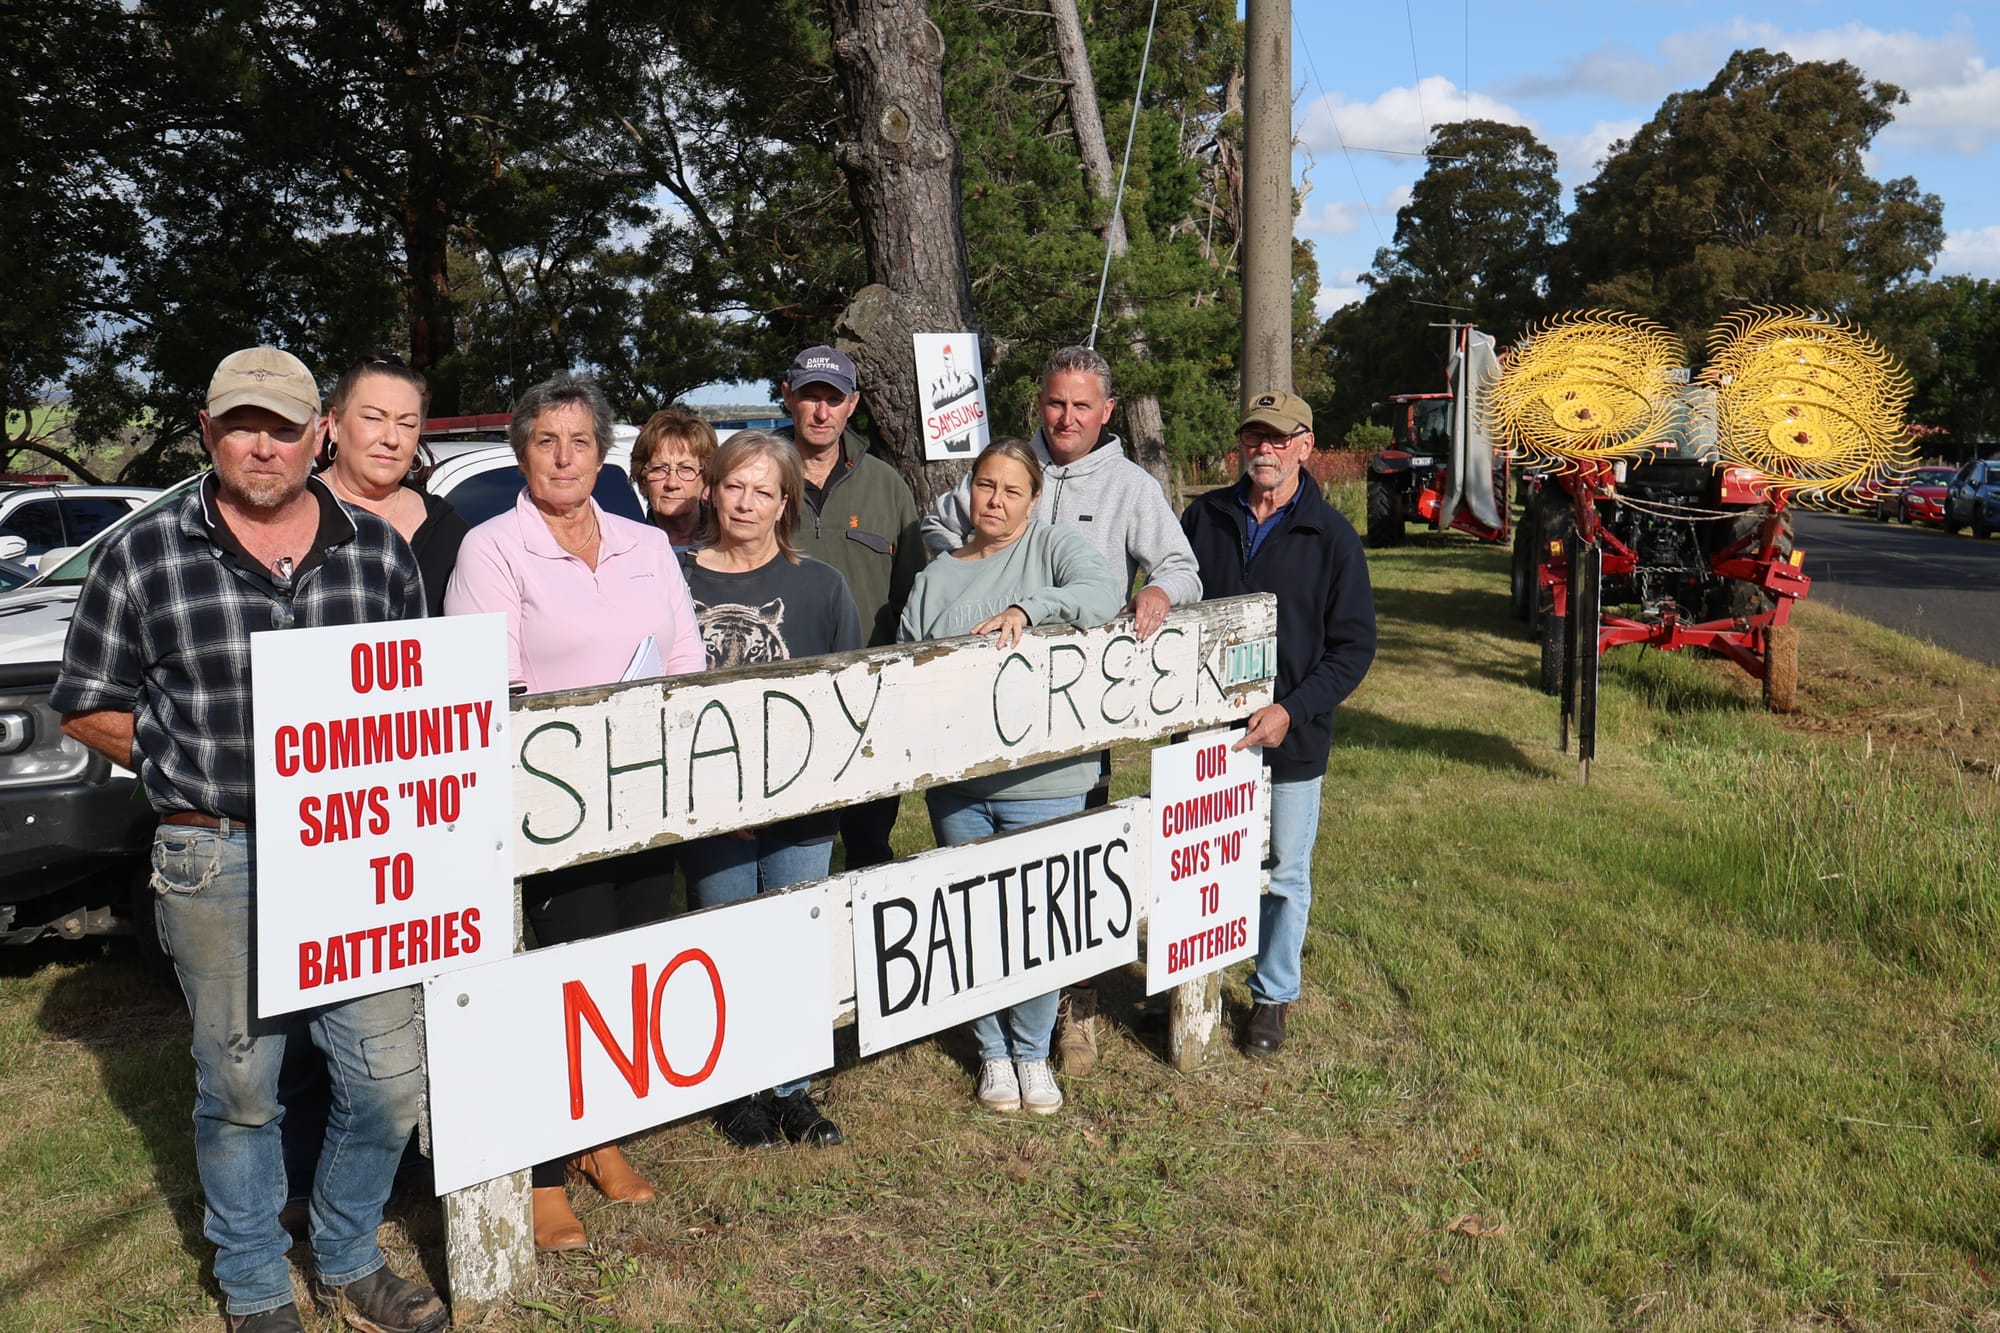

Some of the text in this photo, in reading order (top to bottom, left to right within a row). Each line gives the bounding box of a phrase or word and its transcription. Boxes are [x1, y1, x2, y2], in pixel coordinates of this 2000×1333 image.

[806, 363, 840, 371] MATTERS
[807, 357, 830, 365] DAIRY
[927, 401, 984, 440] SAMSUNG
[350, 638, 423, 694] OUR
[274, 700, 493, 777] COMMUNITY
[520, 622, 1231, 846] SHADY CREEK
[1195, 743, 1227, 782] OUR
[299, 772, 477, 847] SAYS "NO"
[1162, 780, 1256, 838] COMMUNITY
[369, 852, 414, 905] TO
[1170, 828, 1248, 882] SAYS "NO"
[1200, 882, 1219, 918] TO
[298, 907, 482, 990] BATTERIES
[1168, 916, 1247, 975] BATTERIES
[562, 838, 1133, 1120] NO BATTERIES
